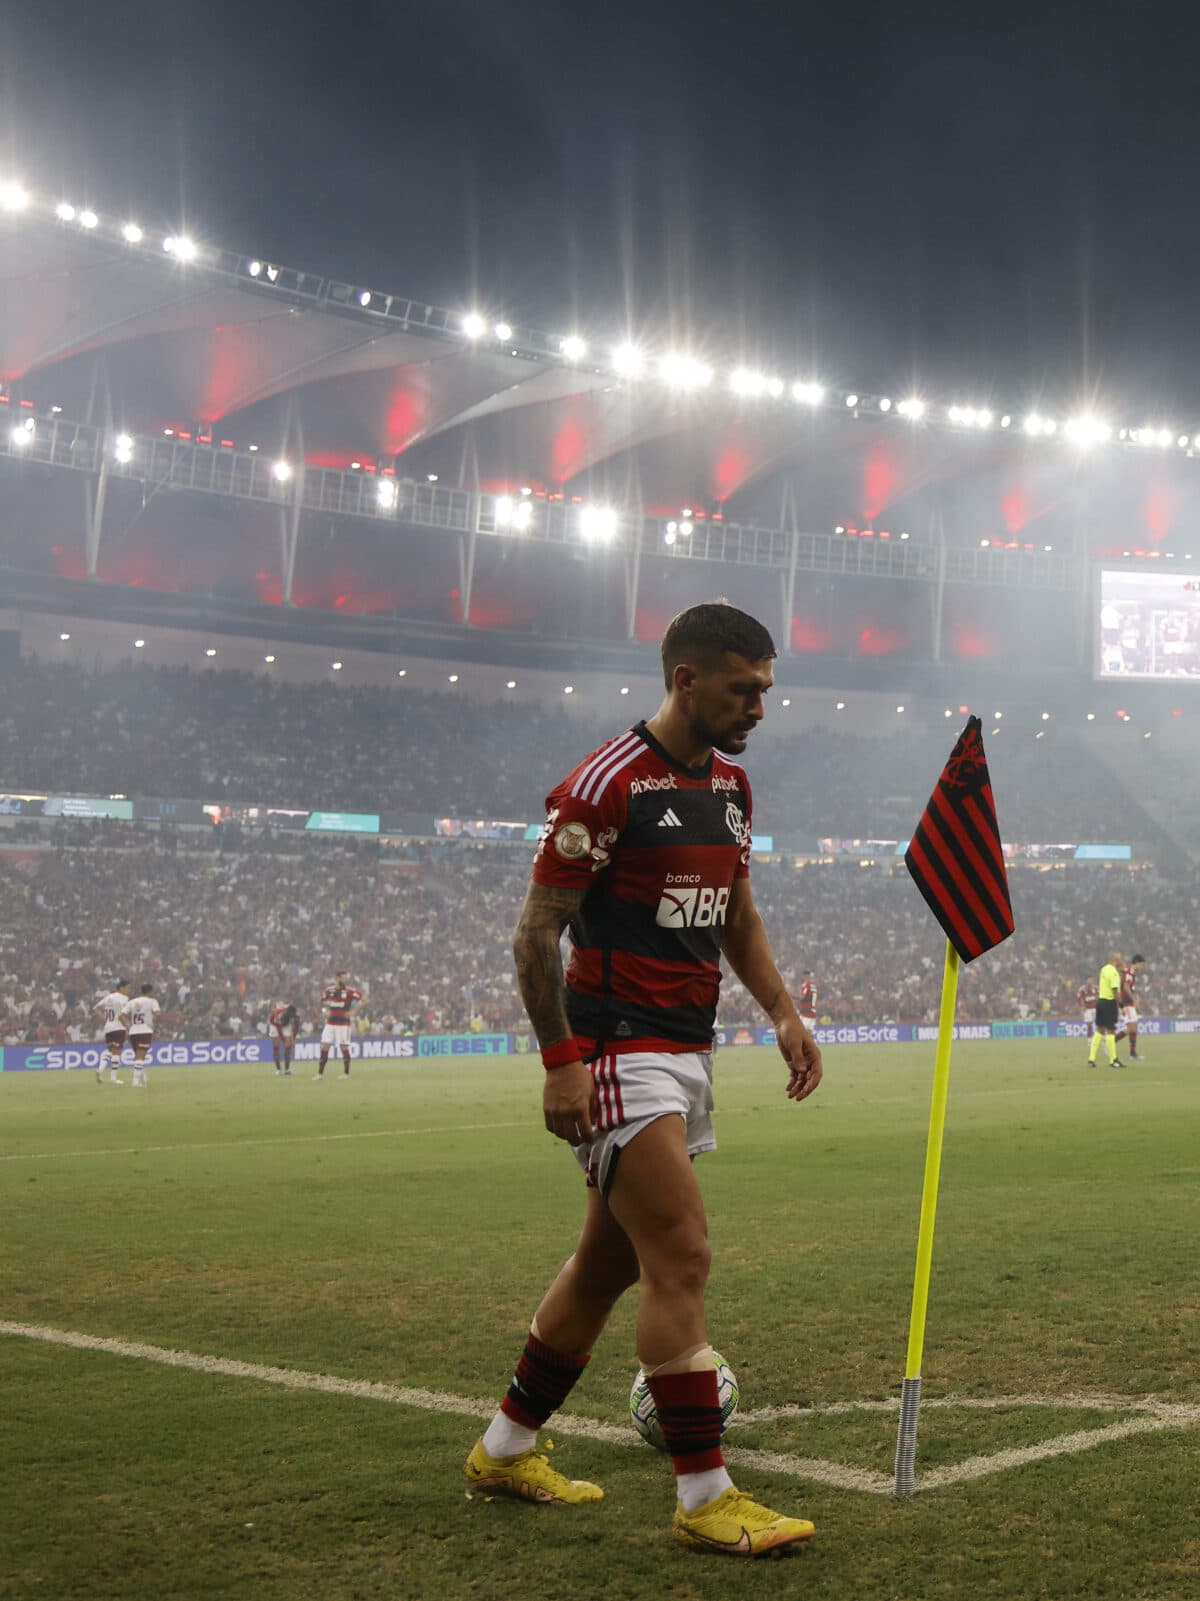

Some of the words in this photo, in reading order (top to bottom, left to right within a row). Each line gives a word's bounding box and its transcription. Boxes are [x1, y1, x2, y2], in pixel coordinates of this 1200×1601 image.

[630, 772, 678, 799] pixbet
[665, 872, 701, 883] banco
[837, 1027, 856, 1044] da
[857, 1026, 898, 1042] Sorte
[959, 1025, 990, 1039] MAIS
[25, 1047, 153, 1070] Espoes
[156, 1043, 189, 1064] da
[191, 1041, 260, 1062] Sorte
[294, 1042, 360, 1060] MUTO
[363, 1039, 414, 1058] MAIS
[421, 1038, 449, 1056] QUE
[451, 1037, 504, 1054] BET
